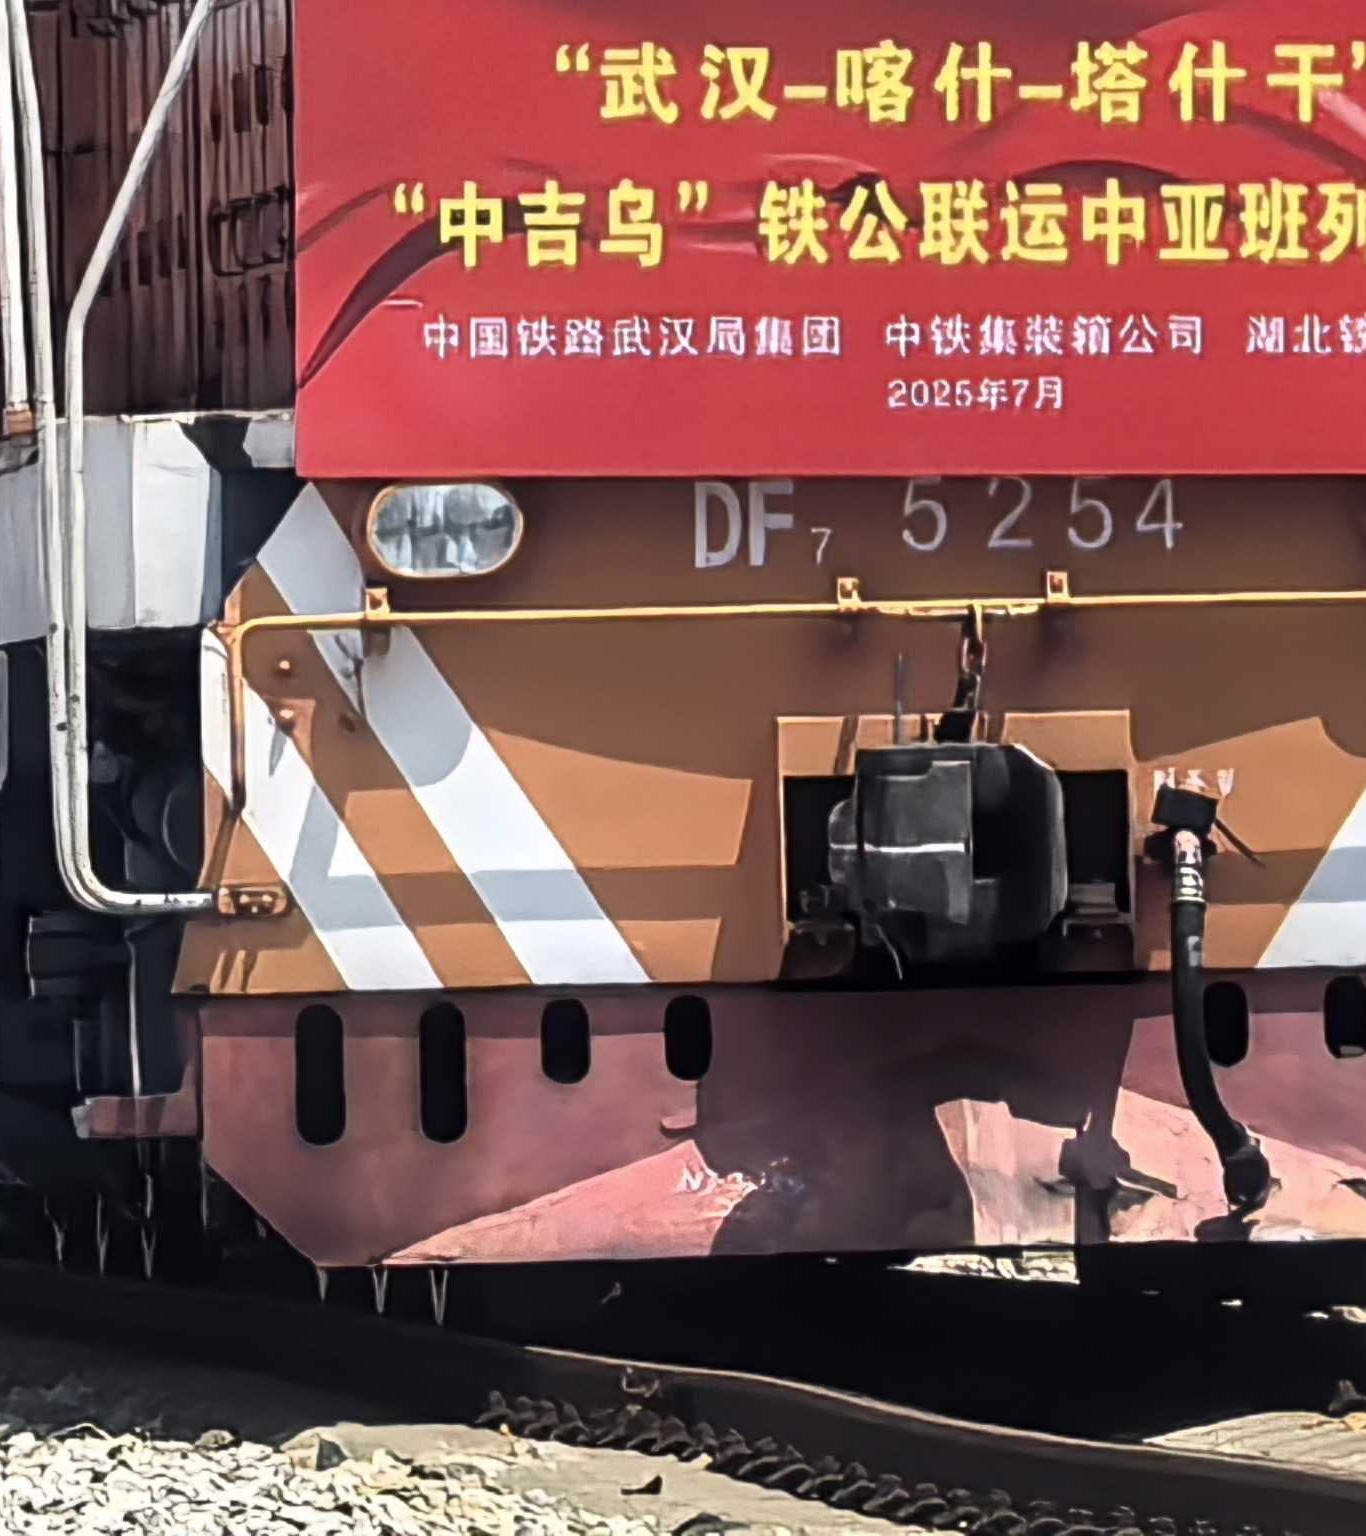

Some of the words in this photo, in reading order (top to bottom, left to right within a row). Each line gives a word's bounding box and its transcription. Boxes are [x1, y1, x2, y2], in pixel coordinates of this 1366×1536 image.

[422, 314, 841, 359] 中国铁路武汉局集团
[885, 313, 1203, 357] 中铁集装箱公司
[887, 375, 1064, 411] 2025年7月
